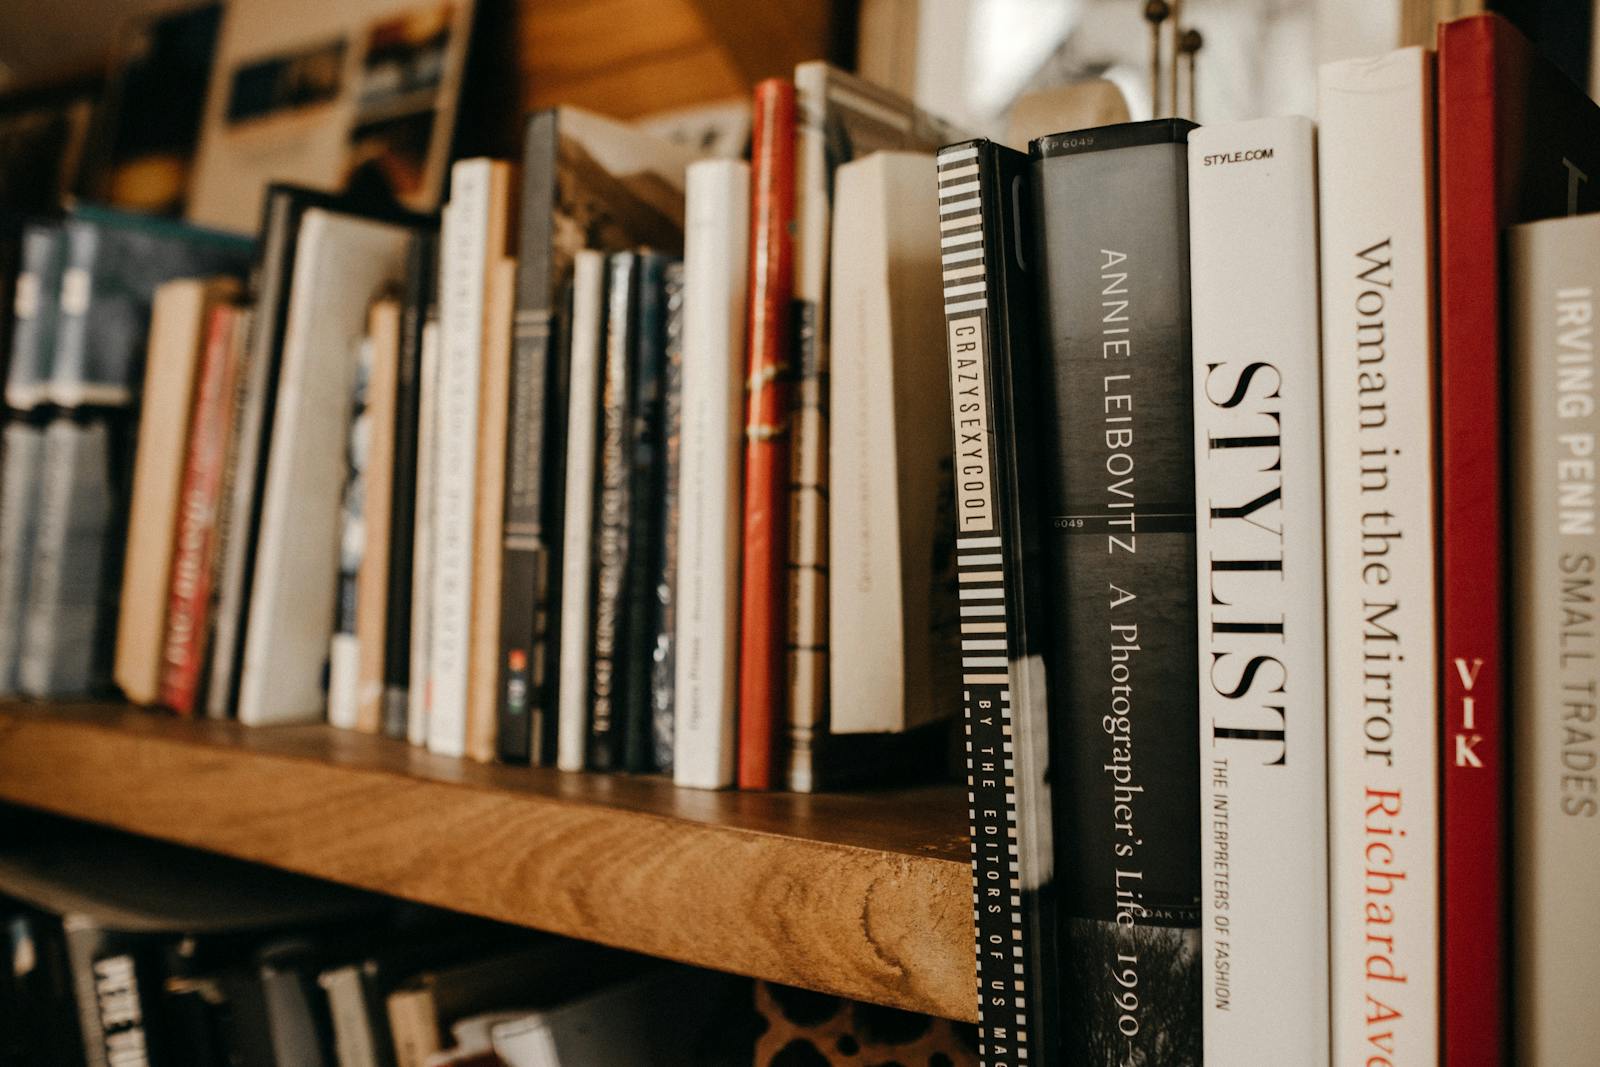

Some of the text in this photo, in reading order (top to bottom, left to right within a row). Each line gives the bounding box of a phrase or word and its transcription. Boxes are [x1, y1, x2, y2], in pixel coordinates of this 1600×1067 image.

[1062, 138, 1094, 149] 6049
[1203, 148, 1274, 167] STYLE.COM
[1100, 249, 1131, 359] ANNIE
[1355, 238, 1393, 430] Woman
[955, 325, 986, 525] CRAZYSEXYCOOL
[1104, 375, 1136, 554] LEIBOVITZ
[1360, 447, 1402, 492] in
[1054, 519, 1084, 528] 6049
[1361, 511, 1403, 585] the
[1556, 287, 1599, 818] IRVING PENN SMALL TRADES
[1109, 583, 1137, 609] A
[1204, 361, 1288, 767] STYLIST
[979, 700, 993, 725] BY
[1363, 600, 1405, 767] Mirror
[981, 747, 995, 788] THE
[984, 809, 1001, 913] EDITORS
[1213, 758, 1232, 1011] THE INTERPRETERS OF FASHION
[1365, 788, 1408, 984] Richard
[1115, 869, 1147, 929] Life
[989, 934, 1003, 960] OF
[991, 980, 1005, 1006] US
